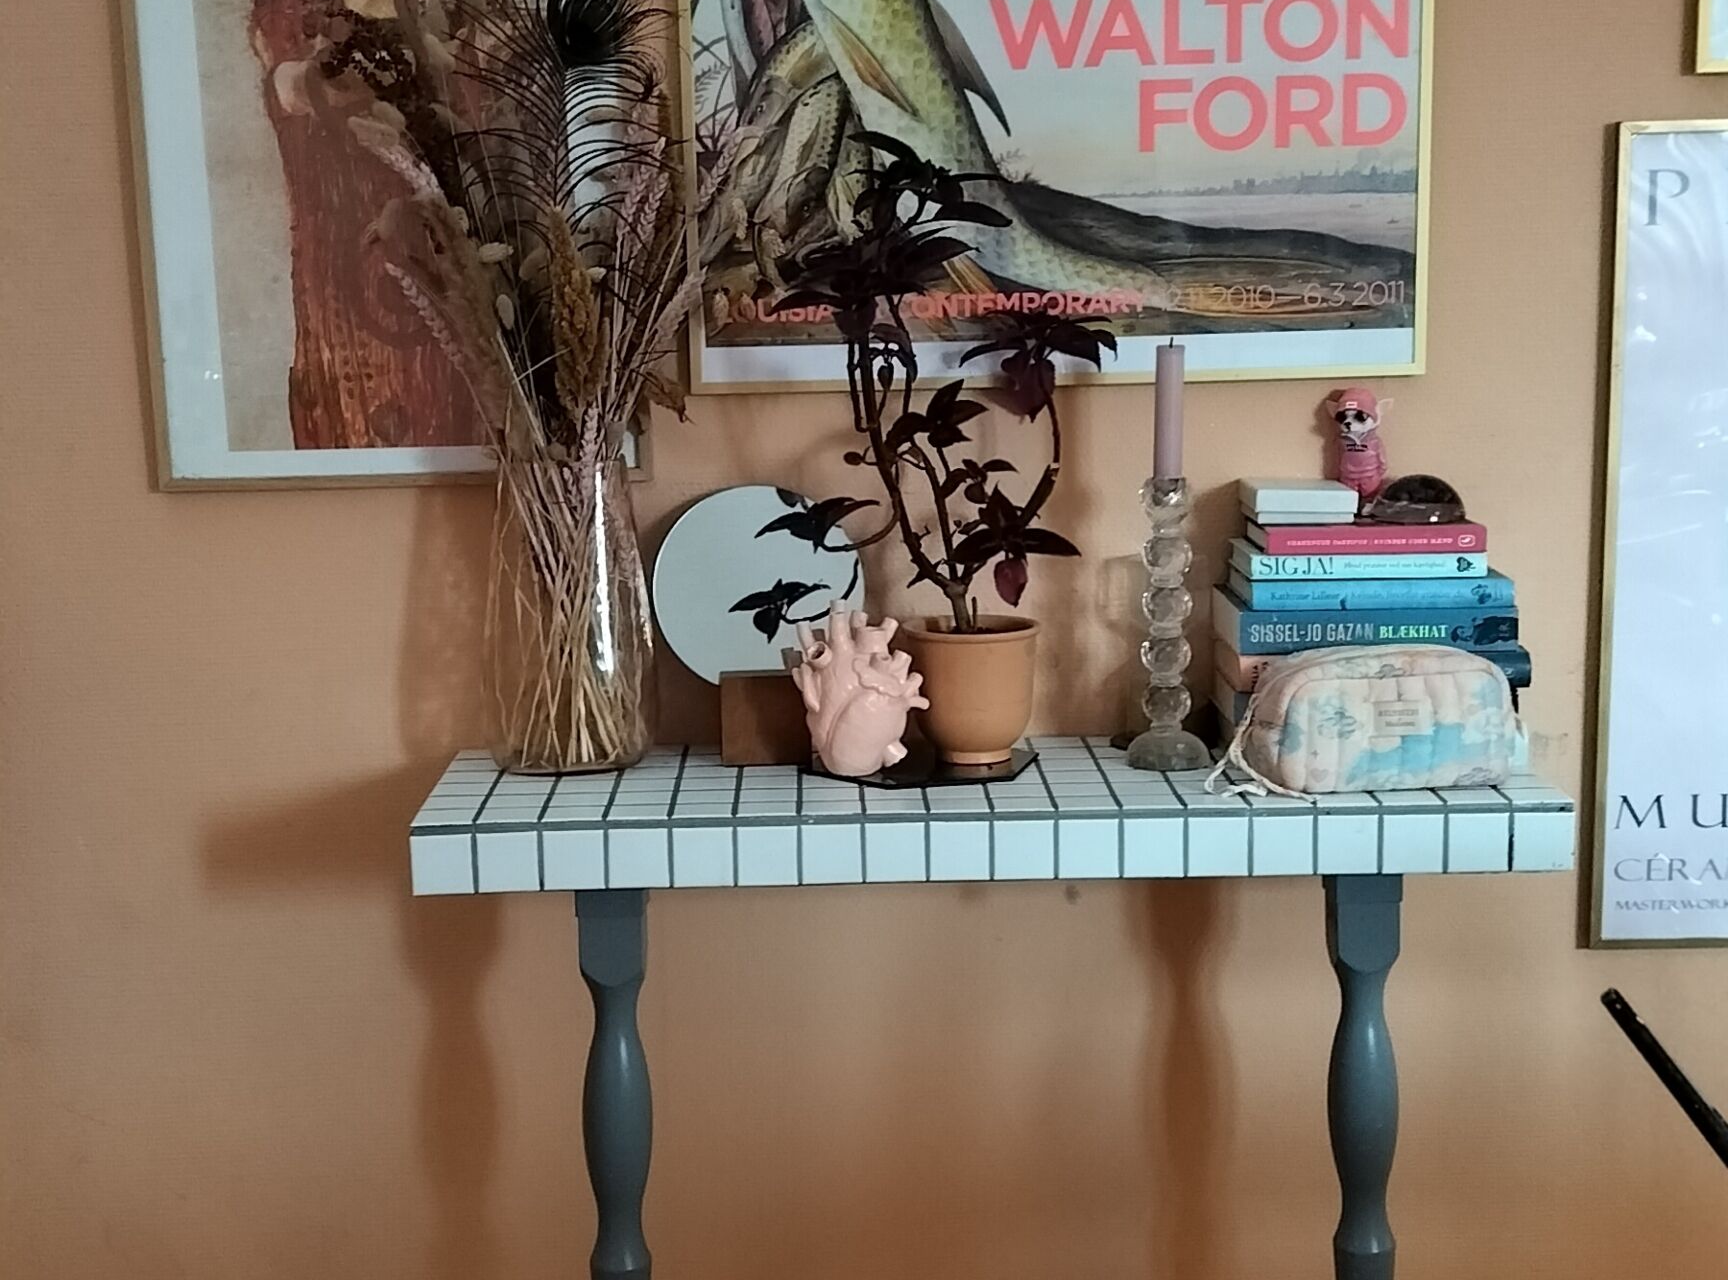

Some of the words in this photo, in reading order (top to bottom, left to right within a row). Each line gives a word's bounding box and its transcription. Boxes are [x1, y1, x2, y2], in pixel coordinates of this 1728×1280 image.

[1138, 72, 1407, 153] FORD
[1259, 556, 1298, 576] SIG
[1302, 556, 1334, 575] JA!
[1250, 623, 1322, 644] SISSEL-JO
[1326, 622, 1375, 642] GAZAN
[1379, 624, 1450, 640] BLÆKHAT
[1613, 851, 1728, 883] CÉRA
